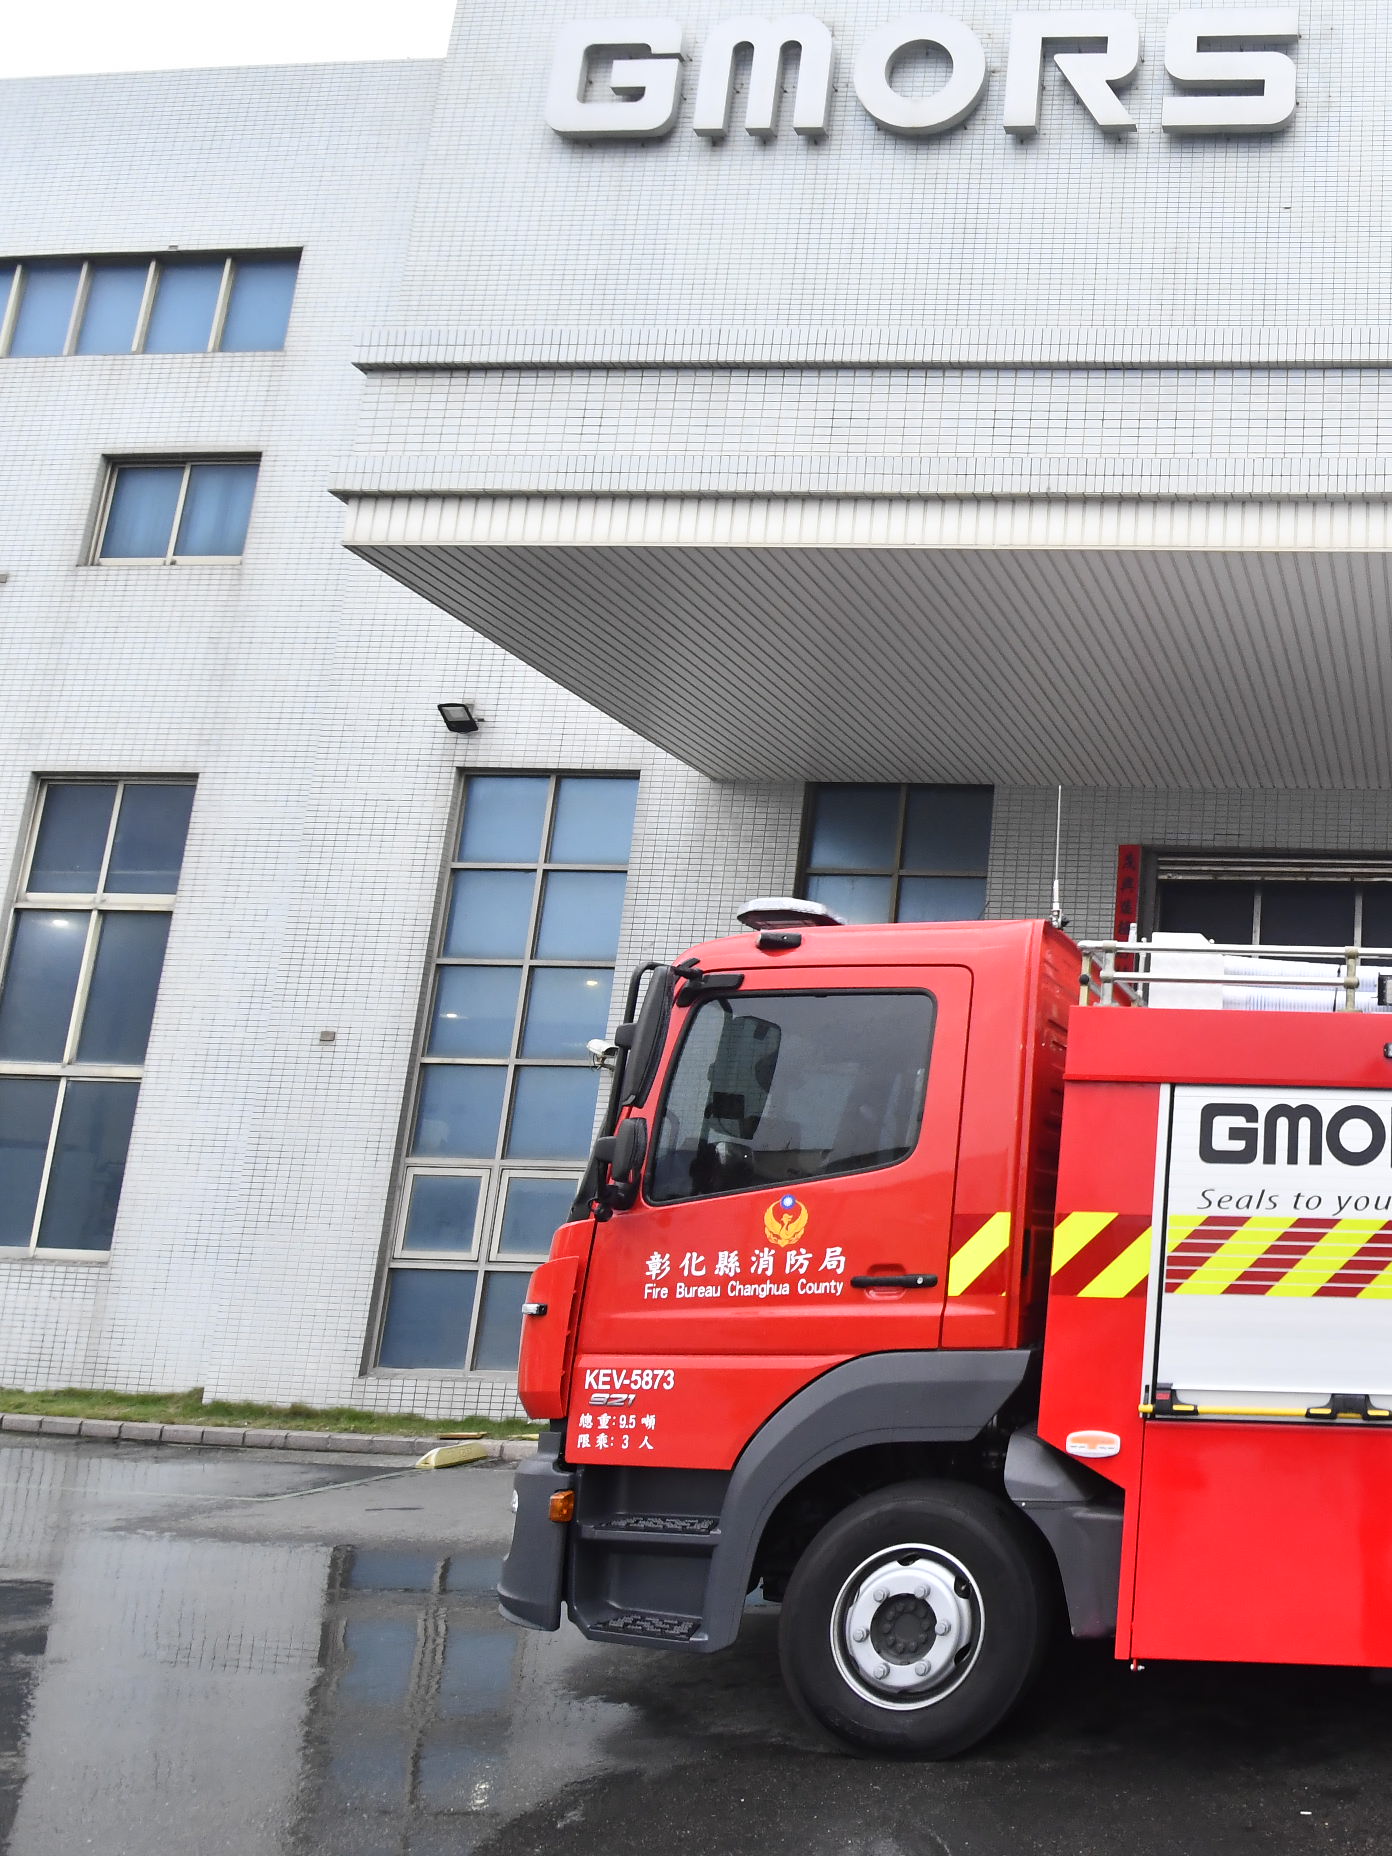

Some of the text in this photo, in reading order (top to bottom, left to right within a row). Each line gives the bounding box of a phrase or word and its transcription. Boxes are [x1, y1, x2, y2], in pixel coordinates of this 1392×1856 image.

[546, 7, 1300, 140] GMORS
[1197, 1188, 1279, 1211] Seals
[1293, 1191, 1322, 1211] to
[645, 1246, 846, 1281] 彰化縣消防局
[644, 1278, 844, 1299] Fire Bureau Changhua County
[584, 1369, 675, 1390] KEV-5873
